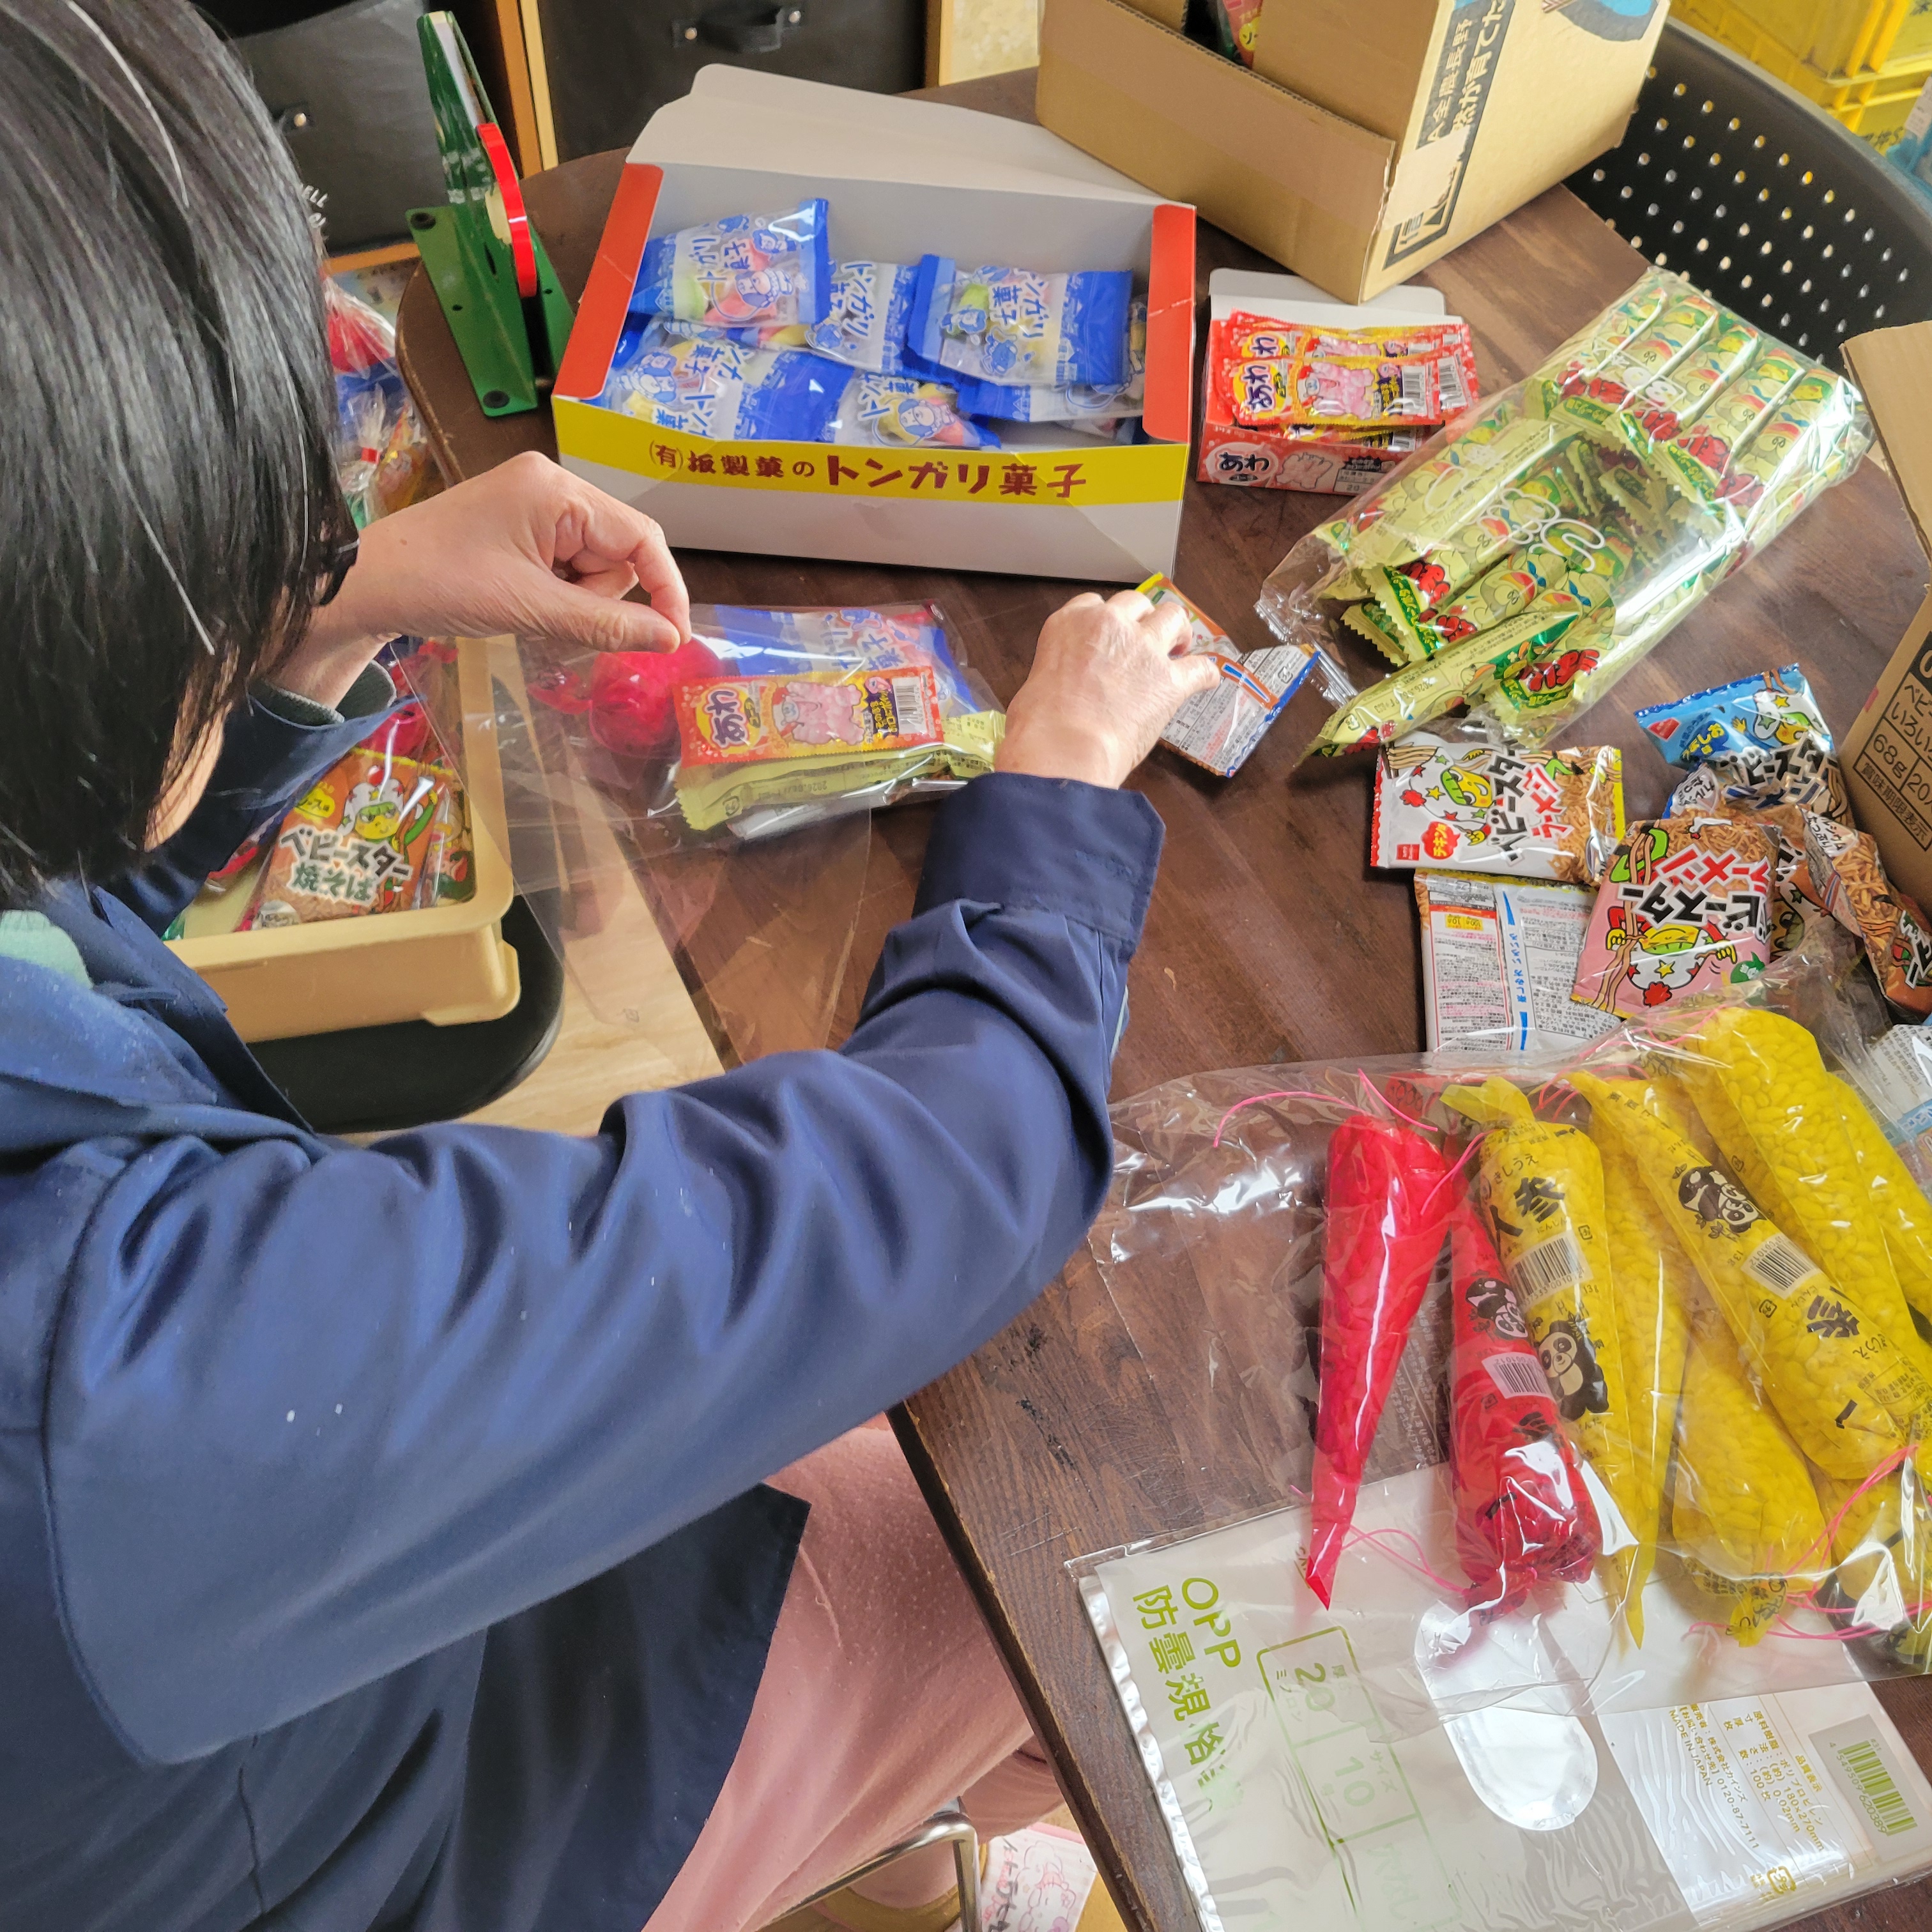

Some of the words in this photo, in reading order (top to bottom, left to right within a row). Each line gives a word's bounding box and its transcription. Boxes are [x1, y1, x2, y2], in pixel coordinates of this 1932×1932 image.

[843, 263, 876, 338] トンガリ
[992, 285, 1022, 326] 菓子
[1242, 364, 1274, 413] あわ
[1219, 451, 1270, 472] あわ
[707, 690, 746, 746] あわ
[1873, 733, 1907, 779] 68g
[1523, 767, 1570, 838] ラーメン
[1860, 762, 1929, 841] 賞味期限表示
[280, 827, 412, 878] ベビースター
[1660, 848, 1770, 893] ラーメン
[293, 861, 376, 902] 焼そば
[1508, 932, 1521, 964] いろいろ
[1513, 968, 1526, 1002] 楽しみ方
[1493, 1153, 1538, 1183] きしうえ
[1807, 1294, 1860, 1339] 参
[1181, 1577, 1241, 1668] OPP
[1294, 1662, 1335, 1712] 20
[1724, 1721, 1734, 1731] 枚
[1744, 1713, 1754, 1723] 寸
[1369, 1749, 1398, 1793] サイズ
[1668, 1709, 1689, 1740] MADE
[1683, 1740, 1694, 1752] IN
[1690, 1752, 1713, 1786] JAPAN
[1335, 1756, 1376, 1807] 10
[1733, 1717, 1744, 1728] 厚
[1773, 1789, 1800, 1833] 0.02mm
[1795, 1754, 1822, 1793] 品質表示
[1836, 1754, 1864, 1791] 549509
[1859, 1795, 1888, 1834] 620389
[1717, 1778, 1759, 1850] 0120-87-7111
